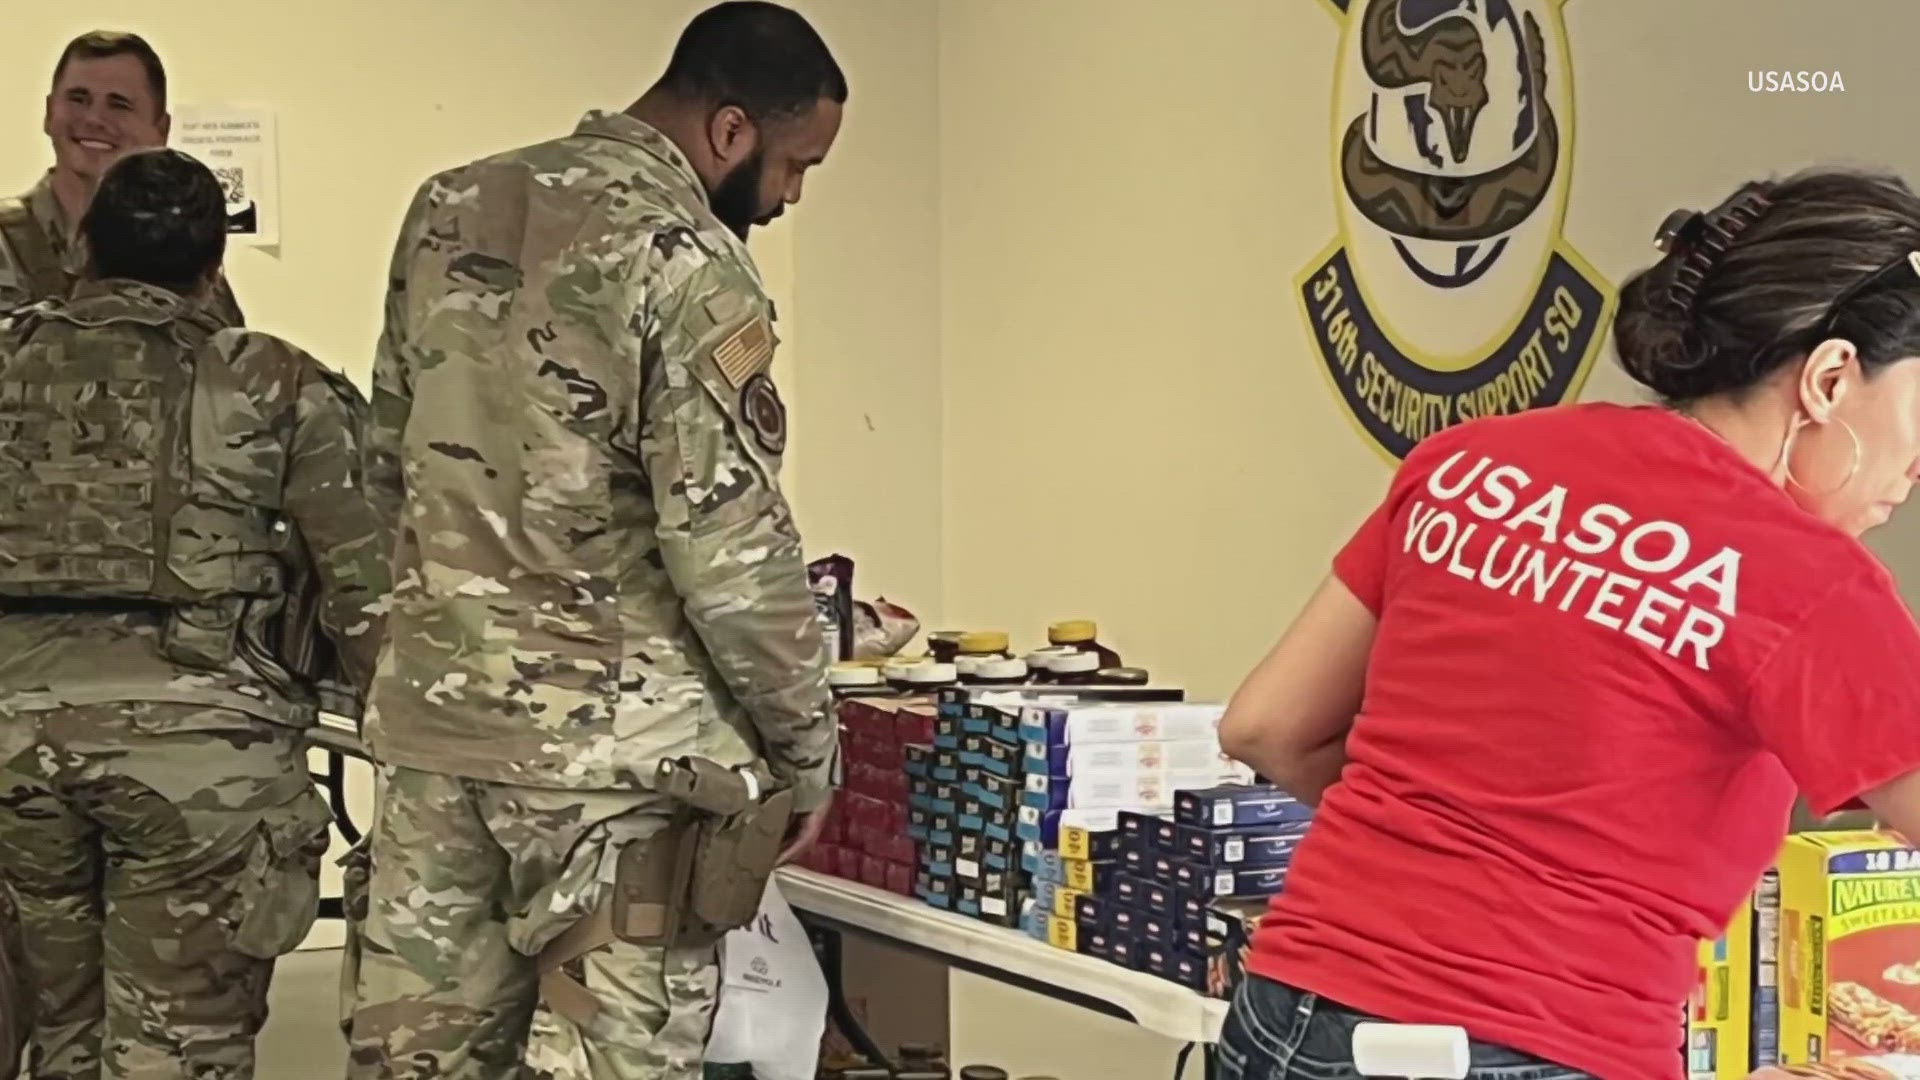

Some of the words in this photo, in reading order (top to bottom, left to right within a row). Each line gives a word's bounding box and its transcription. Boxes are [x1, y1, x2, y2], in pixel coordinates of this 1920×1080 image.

[1313, 264, 1359, 377] 316th
[1355, 351, 1452, 443] SECURITY
[1456, 327, 1554, 421] SUPPORT
[1403, 501, 1726, 671] VOLUNTEER
[1426, 450, 1742, 618] USASOA
[1834, 879, 1911, 916] NATURE
